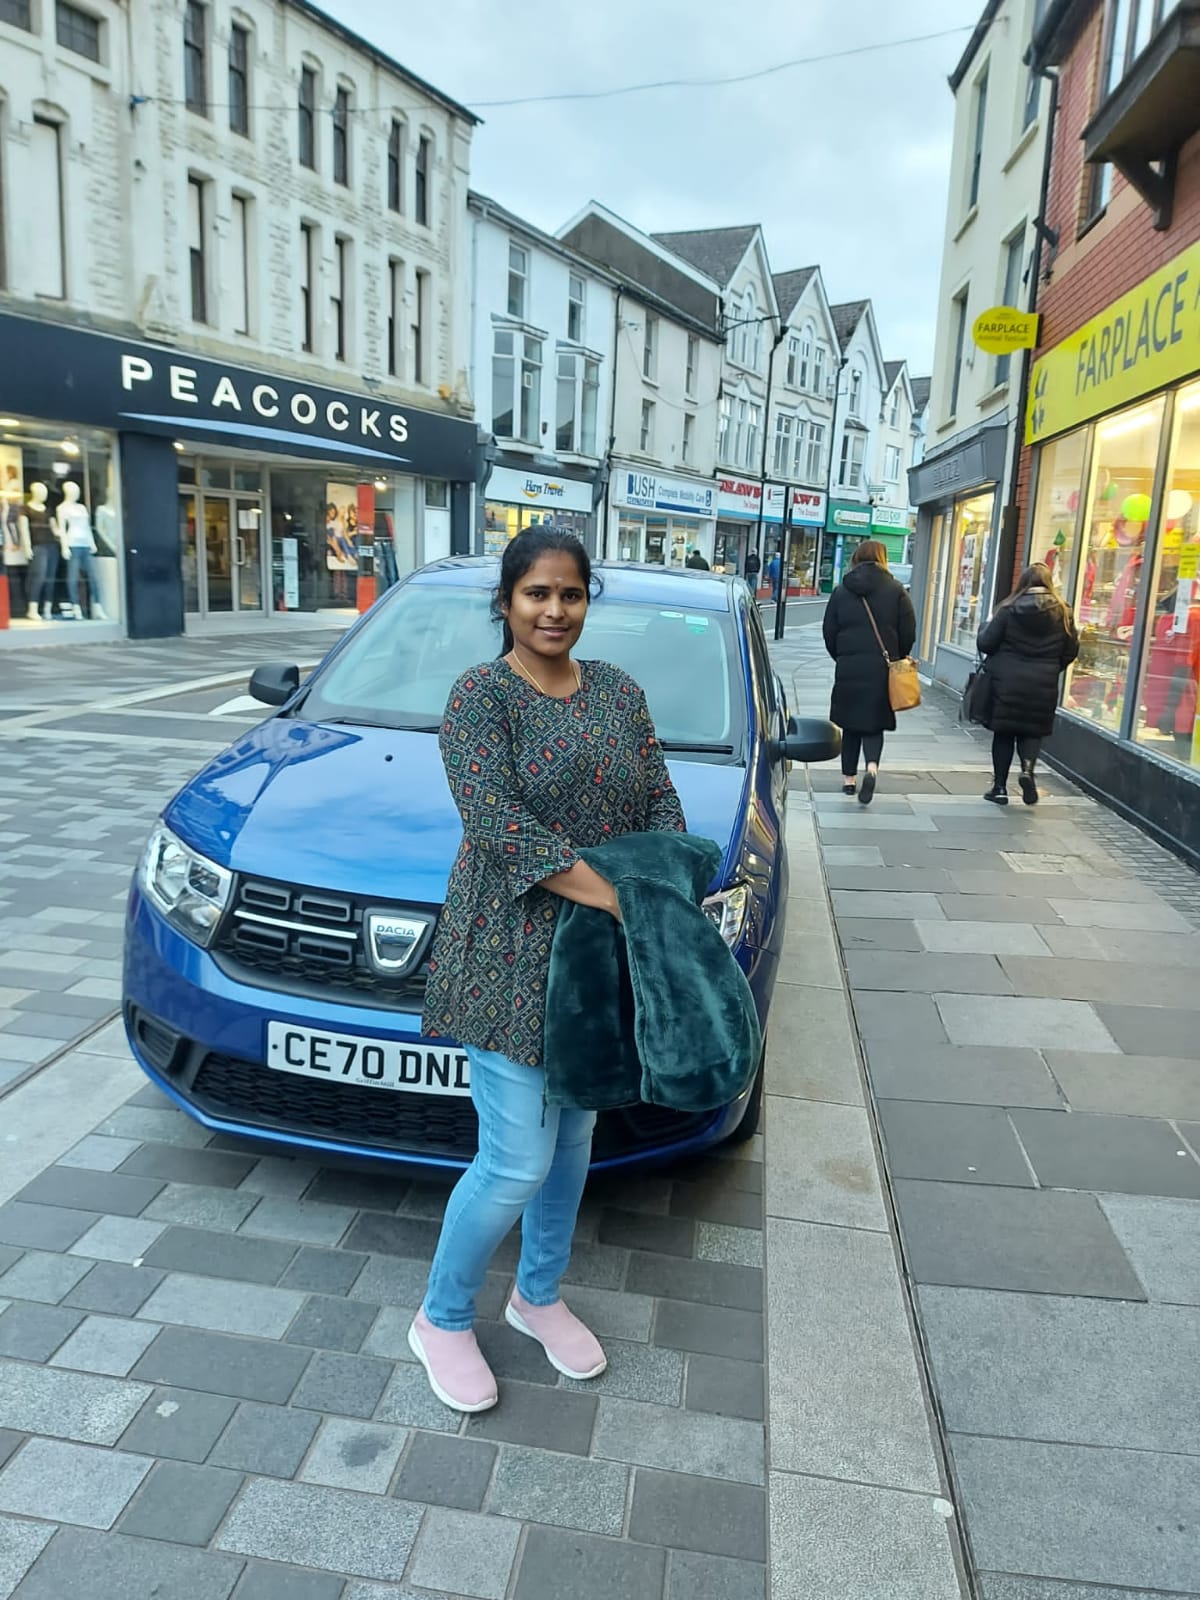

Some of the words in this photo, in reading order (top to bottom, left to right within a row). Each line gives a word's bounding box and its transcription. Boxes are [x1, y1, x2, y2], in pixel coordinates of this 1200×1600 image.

[977, 322, 1031, 334] FARPLACE
[1075, 270, 1189, 397] FARPLACE
[121, 354, 409, 443] PEACOCKS
[628, 473, 656, 498] BUSH
[375, 924, 416, 938] DACIA
[284, 1030, 385, 1080] CE70
